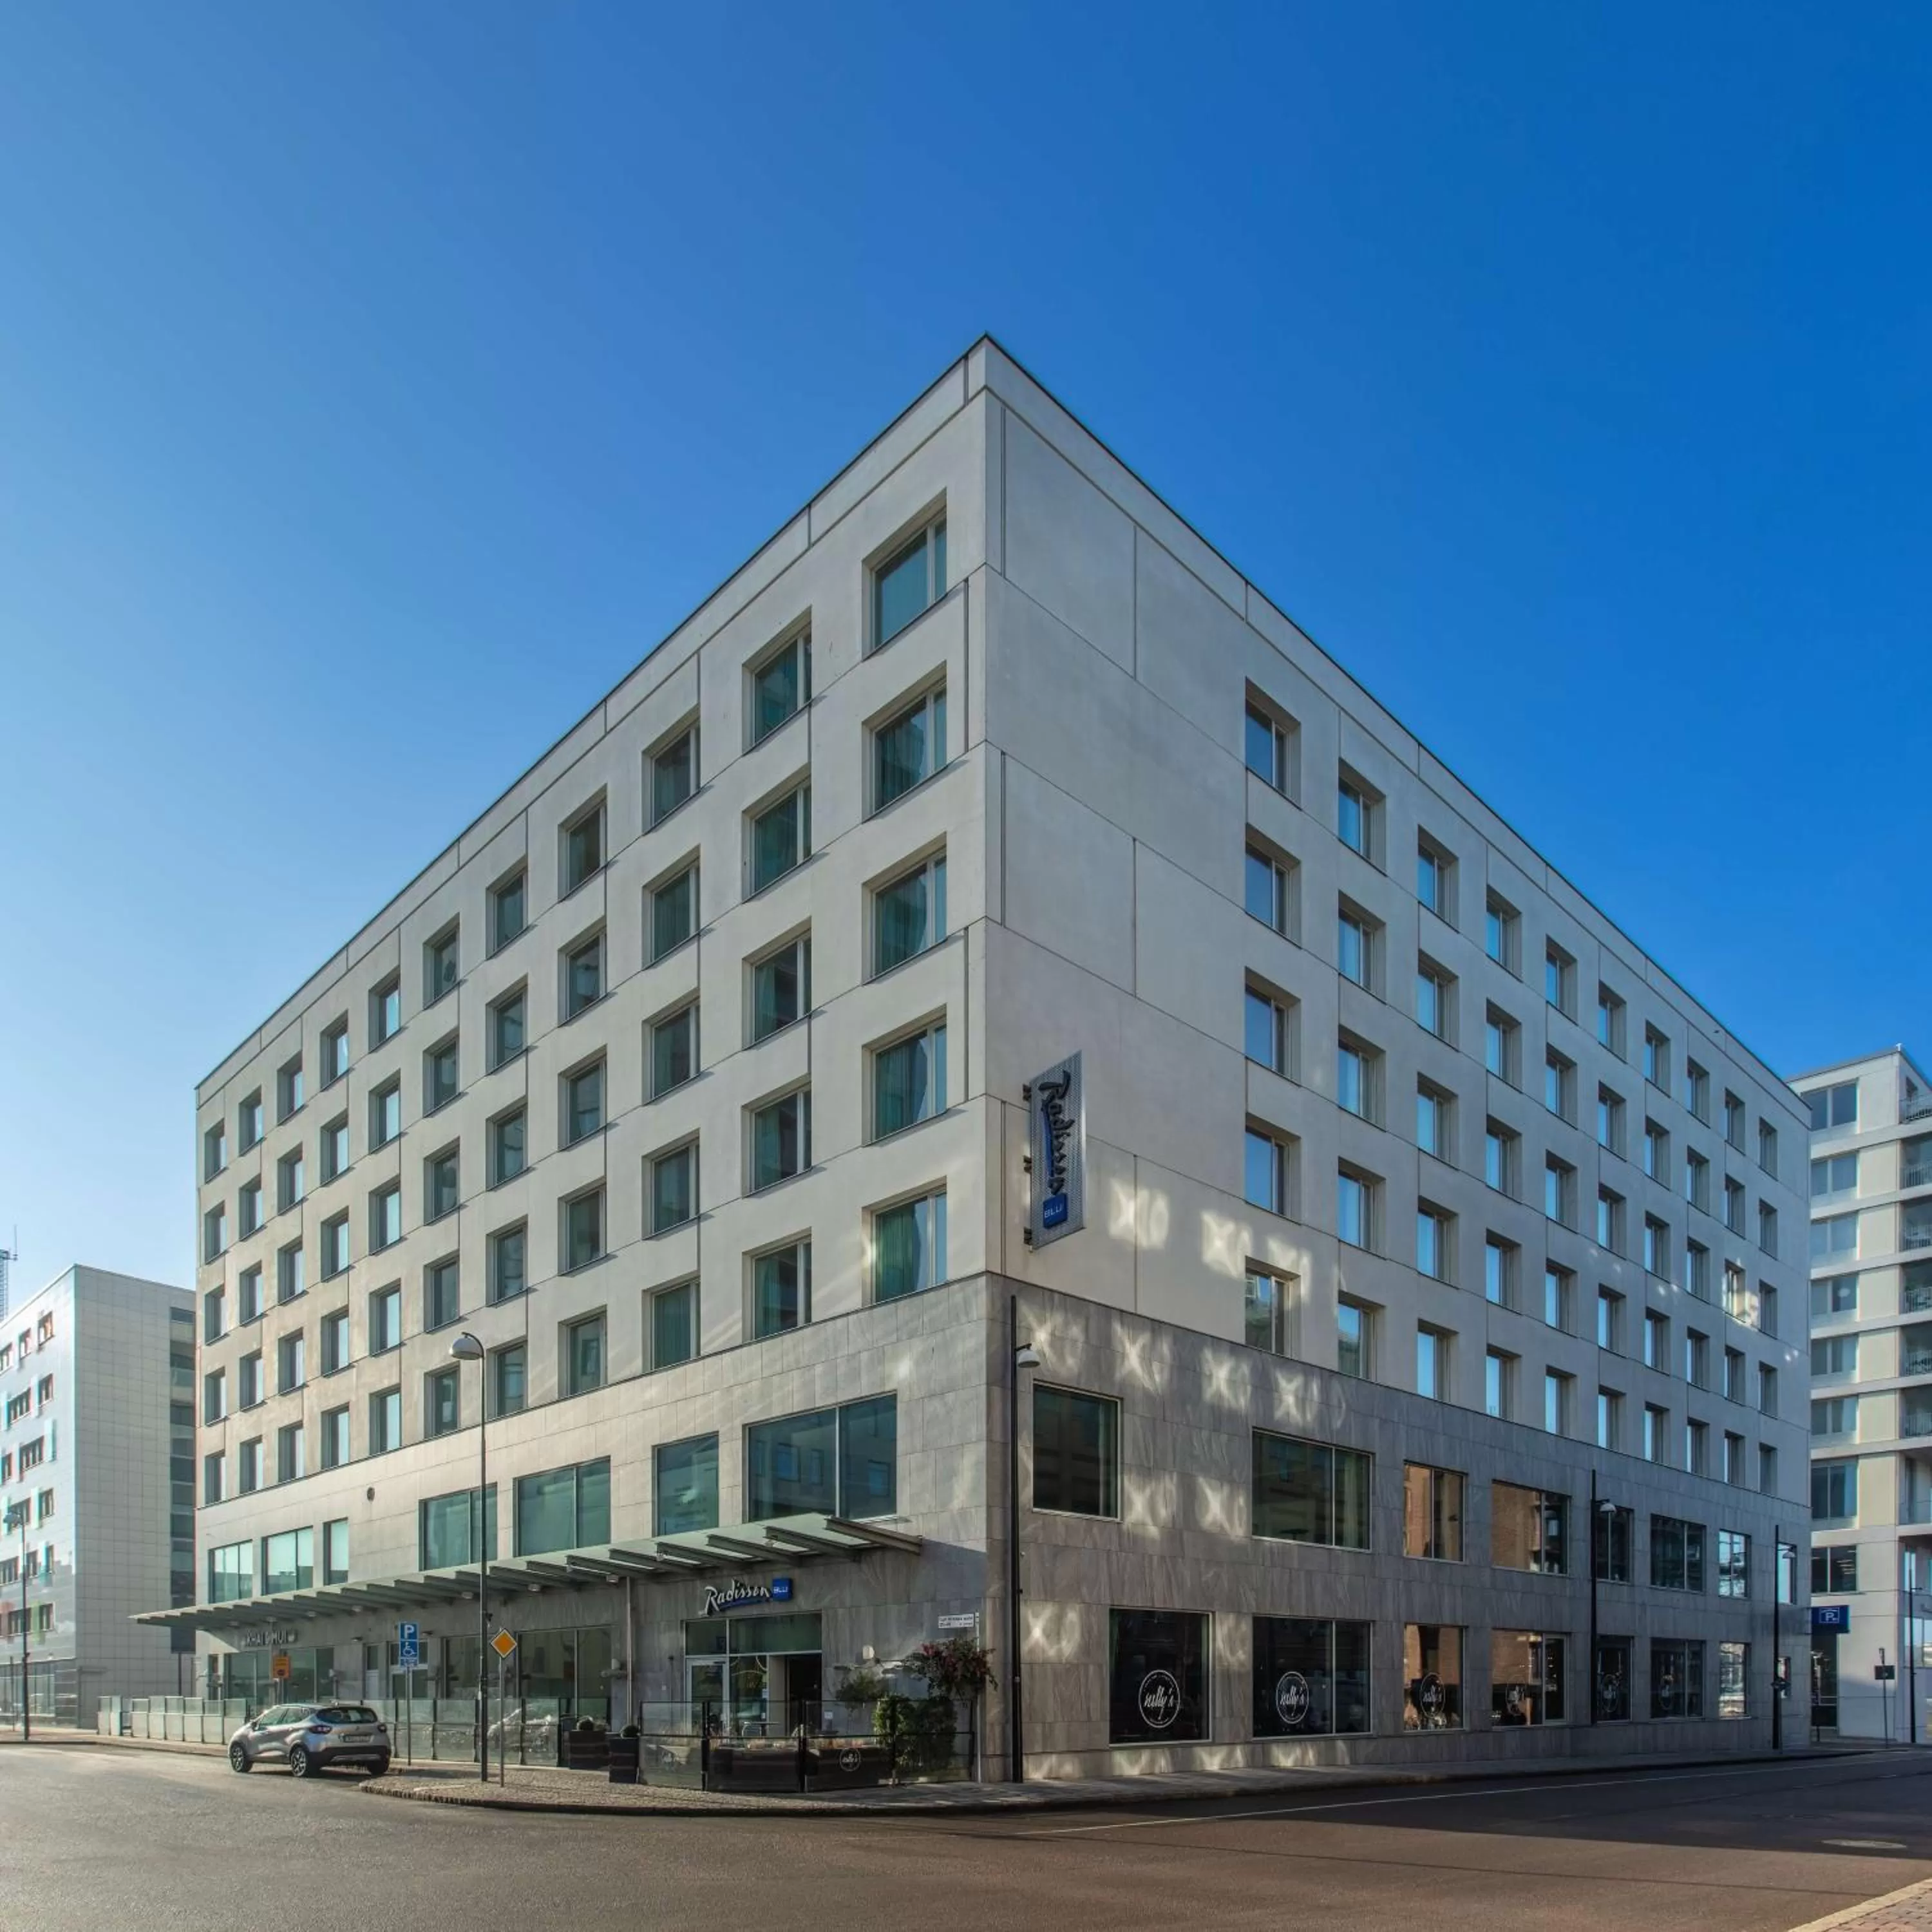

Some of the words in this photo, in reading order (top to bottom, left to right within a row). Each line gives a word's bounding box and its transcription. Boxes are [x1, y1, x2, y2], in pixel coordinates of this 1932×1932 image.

[1038, 1069, 1075, 1195] Radisson
[1044, 1204, 1063, 1219] BLU
[699, 1577, 770, 1616] Radisson
[404, 1624, 415, 1639] P
